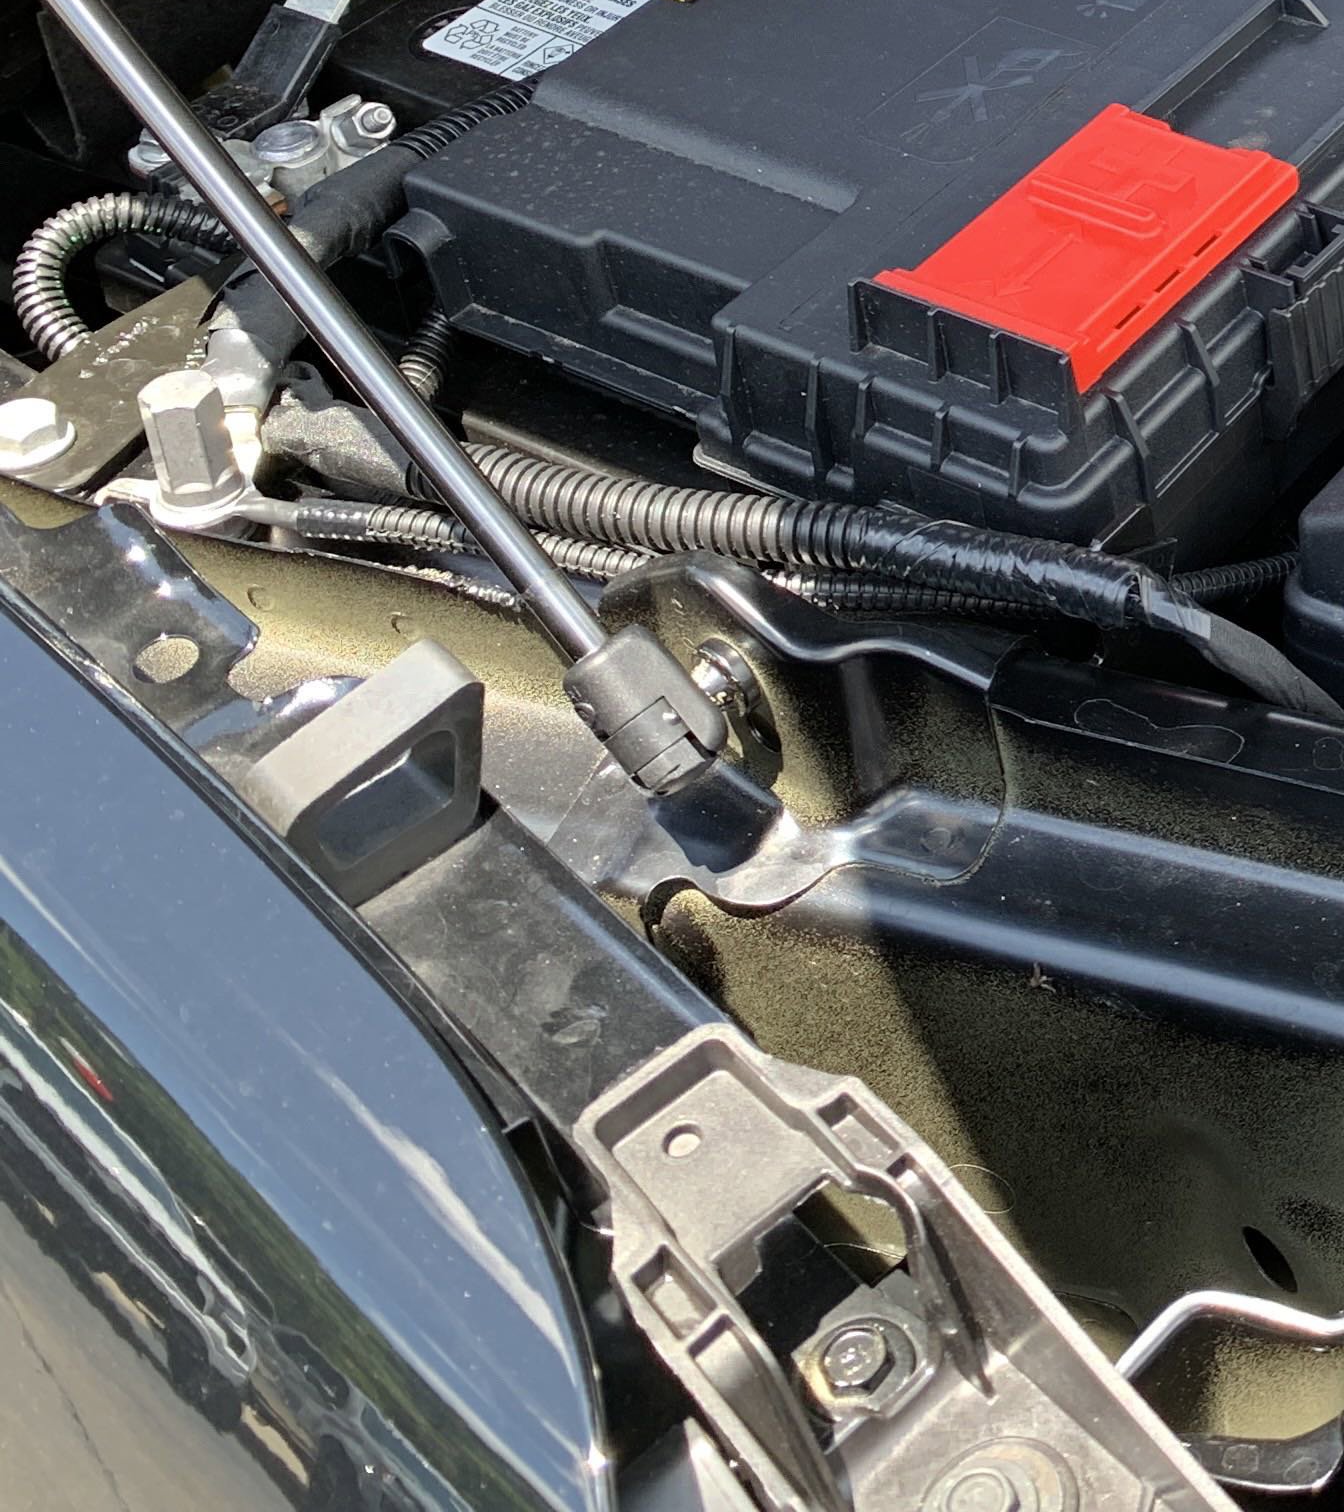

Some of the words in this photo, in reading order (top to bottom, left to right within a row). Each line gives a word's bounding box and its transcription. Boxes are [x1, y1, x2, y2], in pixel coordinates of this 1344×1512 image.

[513, 0, 536, 12] GAZ
[530, 9, 578, 28] EXPLOSIFS
[550, 3, 570, 14] LES
